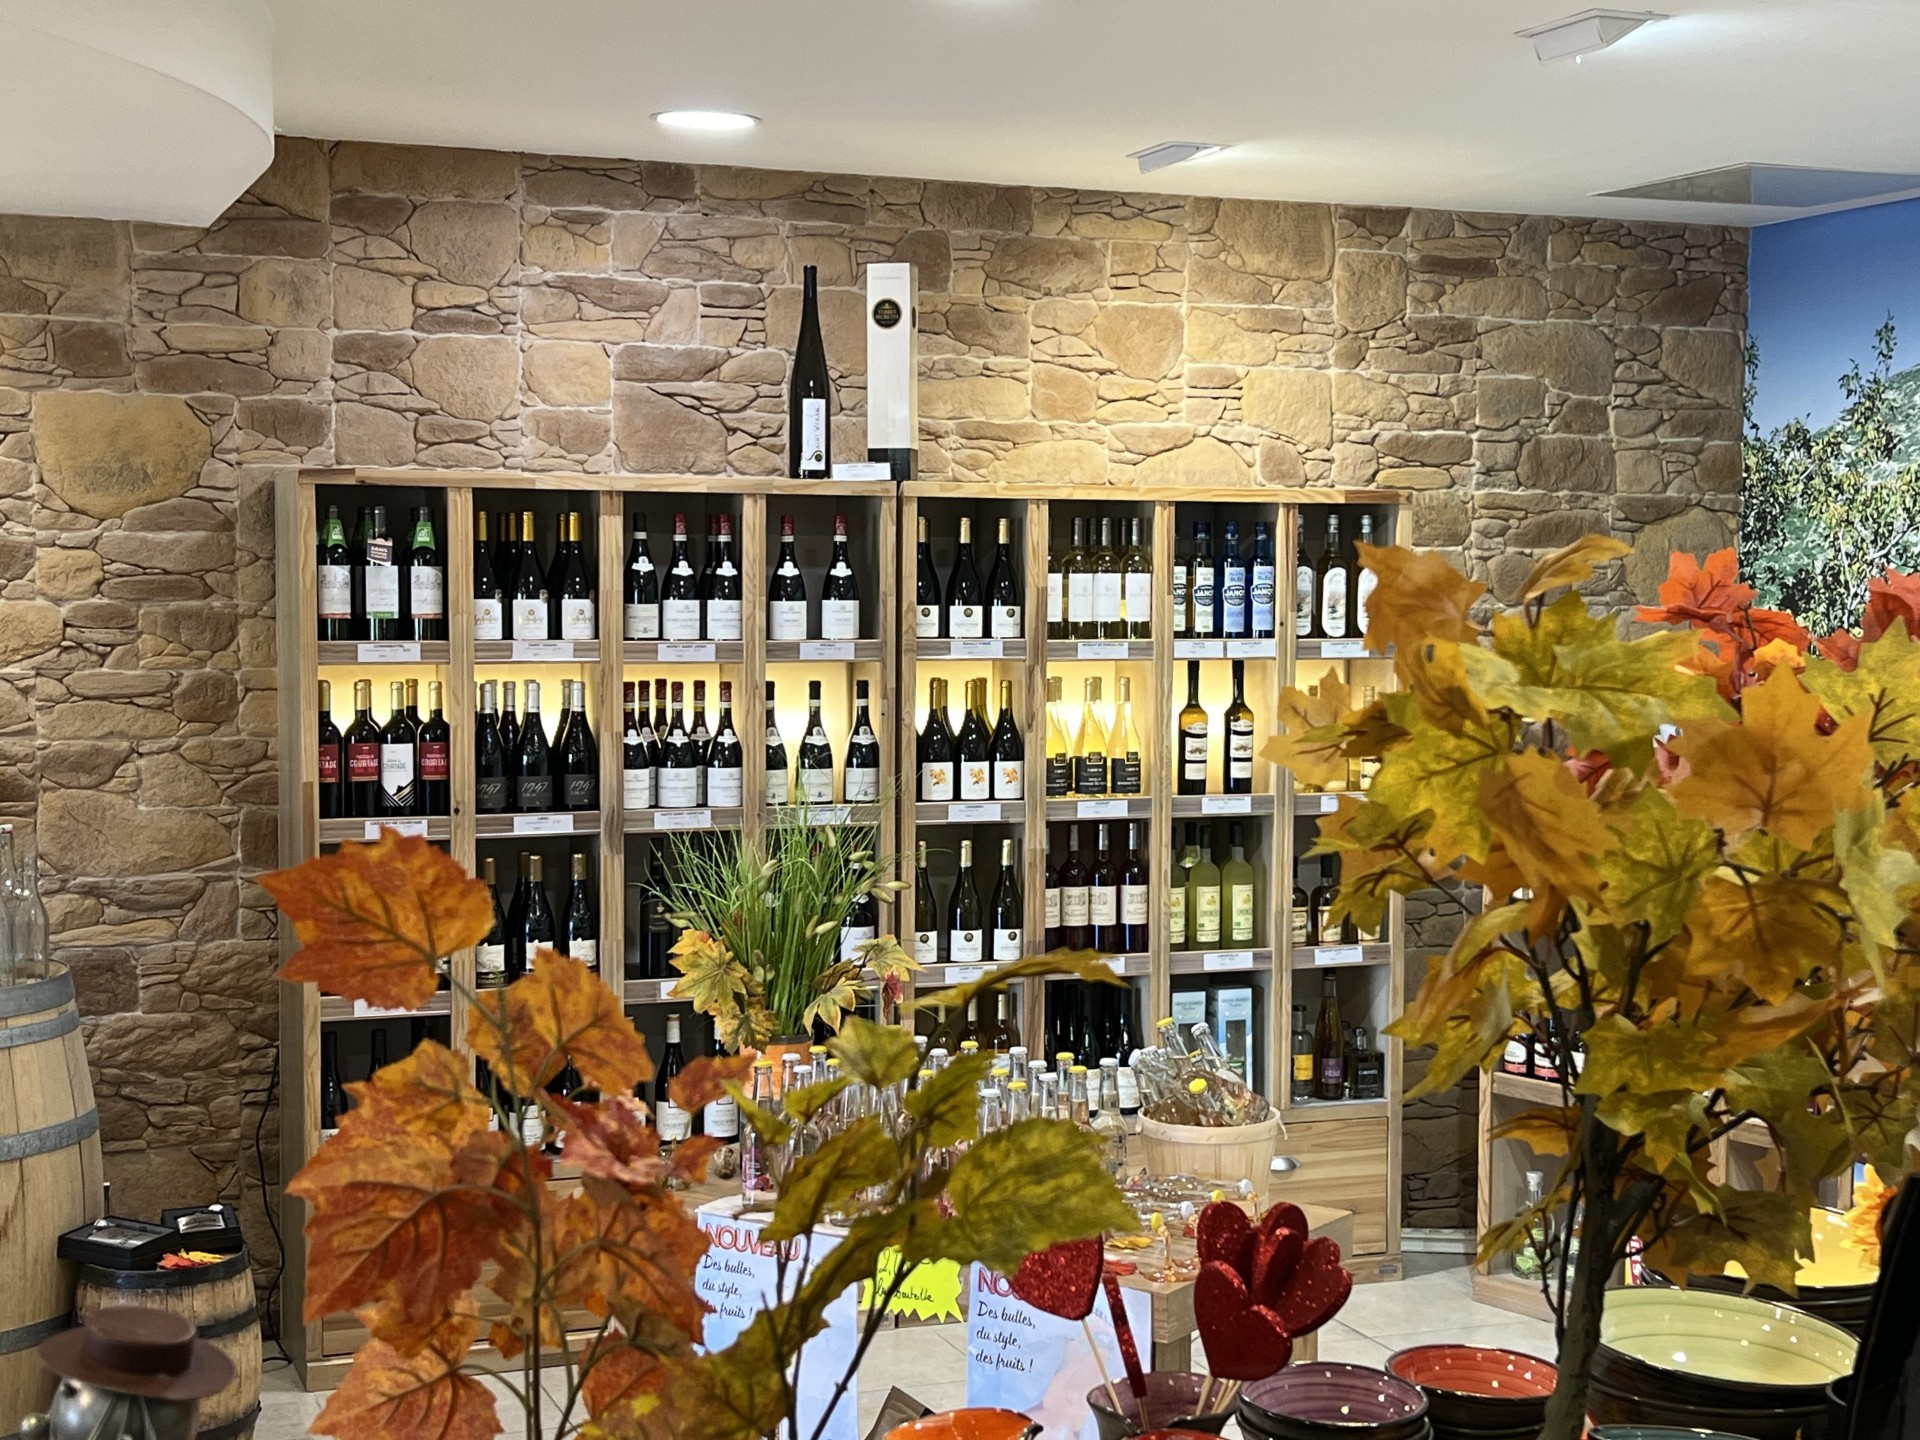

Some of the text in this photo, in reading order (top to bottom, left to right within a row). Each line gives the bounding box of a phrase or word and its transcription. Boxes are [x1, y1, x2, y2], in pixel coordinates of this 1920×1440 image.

[703, 1254, 756, 1279] Des bulles,
[702, 1277, 743, 1299] du style,
[720, 1301, 746, 1320] fruits
[976, 1300, 1037, 1330] Des bulles,
[976, 1325, 1022, 1350] du style,
[975, 1348, 1034, 1373] des fruits !
